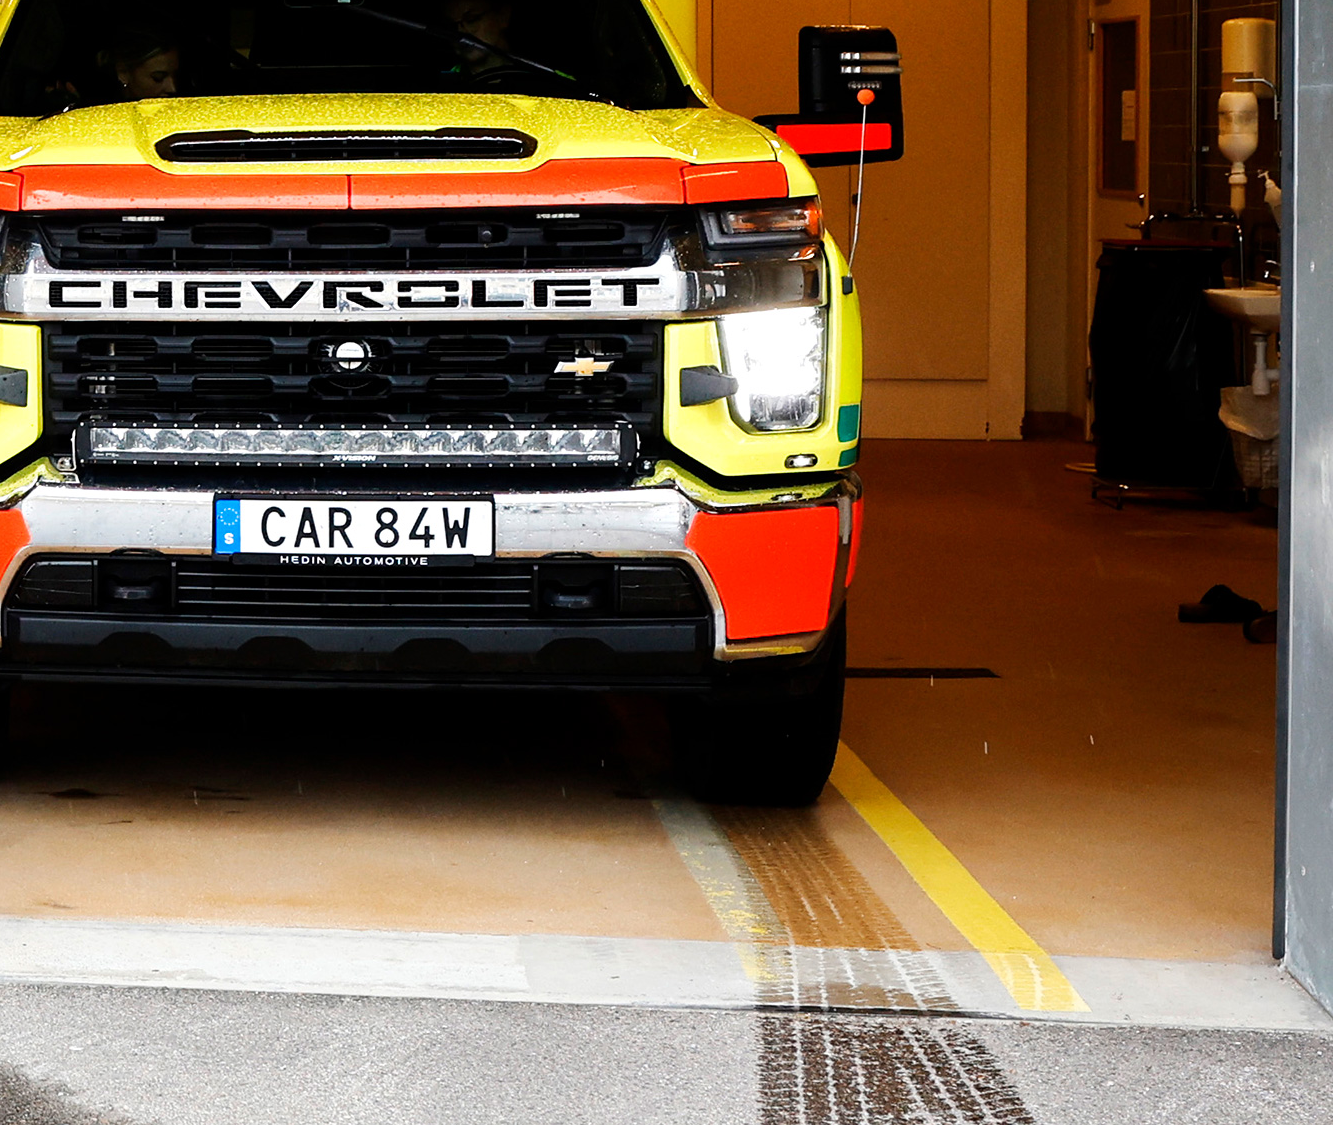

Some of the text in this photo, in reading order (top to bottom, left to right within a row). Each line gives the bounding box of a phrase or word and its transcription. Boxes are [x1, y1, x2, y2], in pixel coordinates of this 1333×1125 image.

[47, 277, 660, 309] CHEVROLET
[260, 505, 472, 549] CAR 84W
[223, 532, 235, 545] S
[279, 555, 429, 566] HEDIN AUTOMOTIVE
